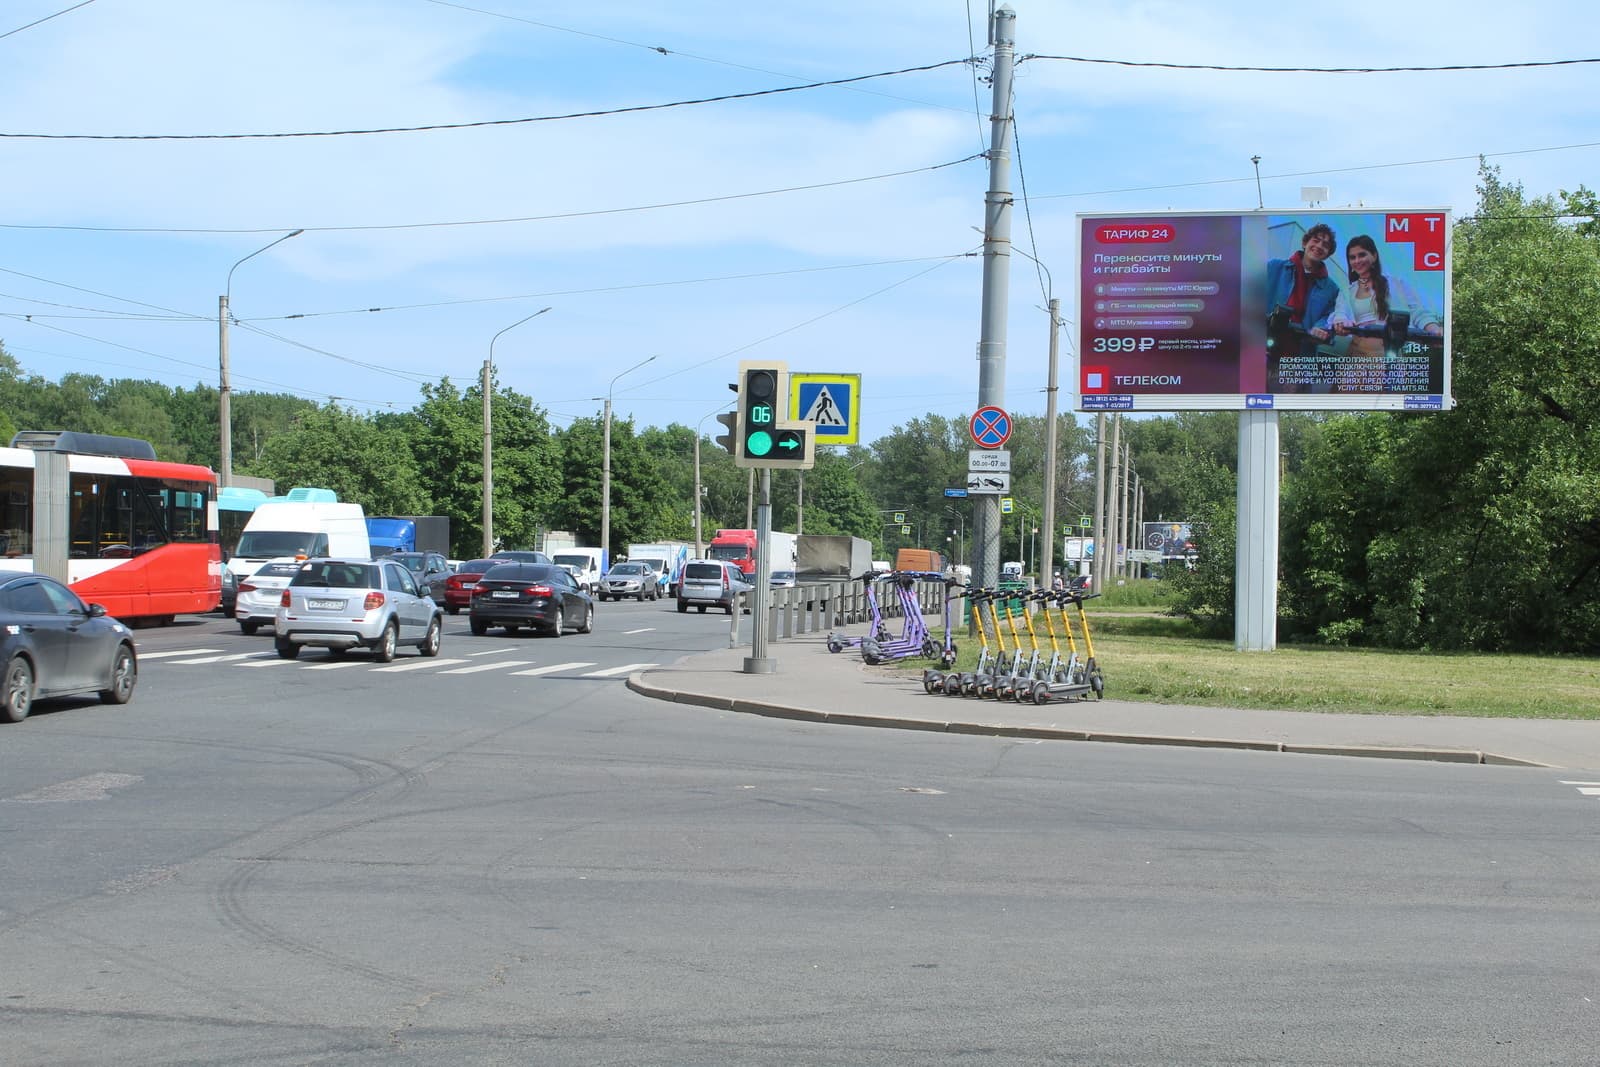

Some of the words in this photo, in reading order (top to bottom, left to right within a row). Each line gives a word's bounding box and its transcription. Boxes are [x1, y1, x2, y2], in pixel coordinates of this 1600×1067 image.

[1104, 230, 1149, 239] ТАРИФ
[1152, 229, 1168, 239] 24
[1094, 254, 1170, 264] Переносите
[1173, 253, 1222, 264] минуты
[1104, 264, 1171, 273] гигабайты
[1093, 337, 1136, 352] 399
[1407, 343, 1430, 352] 18+
[1114, 376, 1182, 385] ТЕЛЕКОМ
[752, 406, 770, 422] 06
